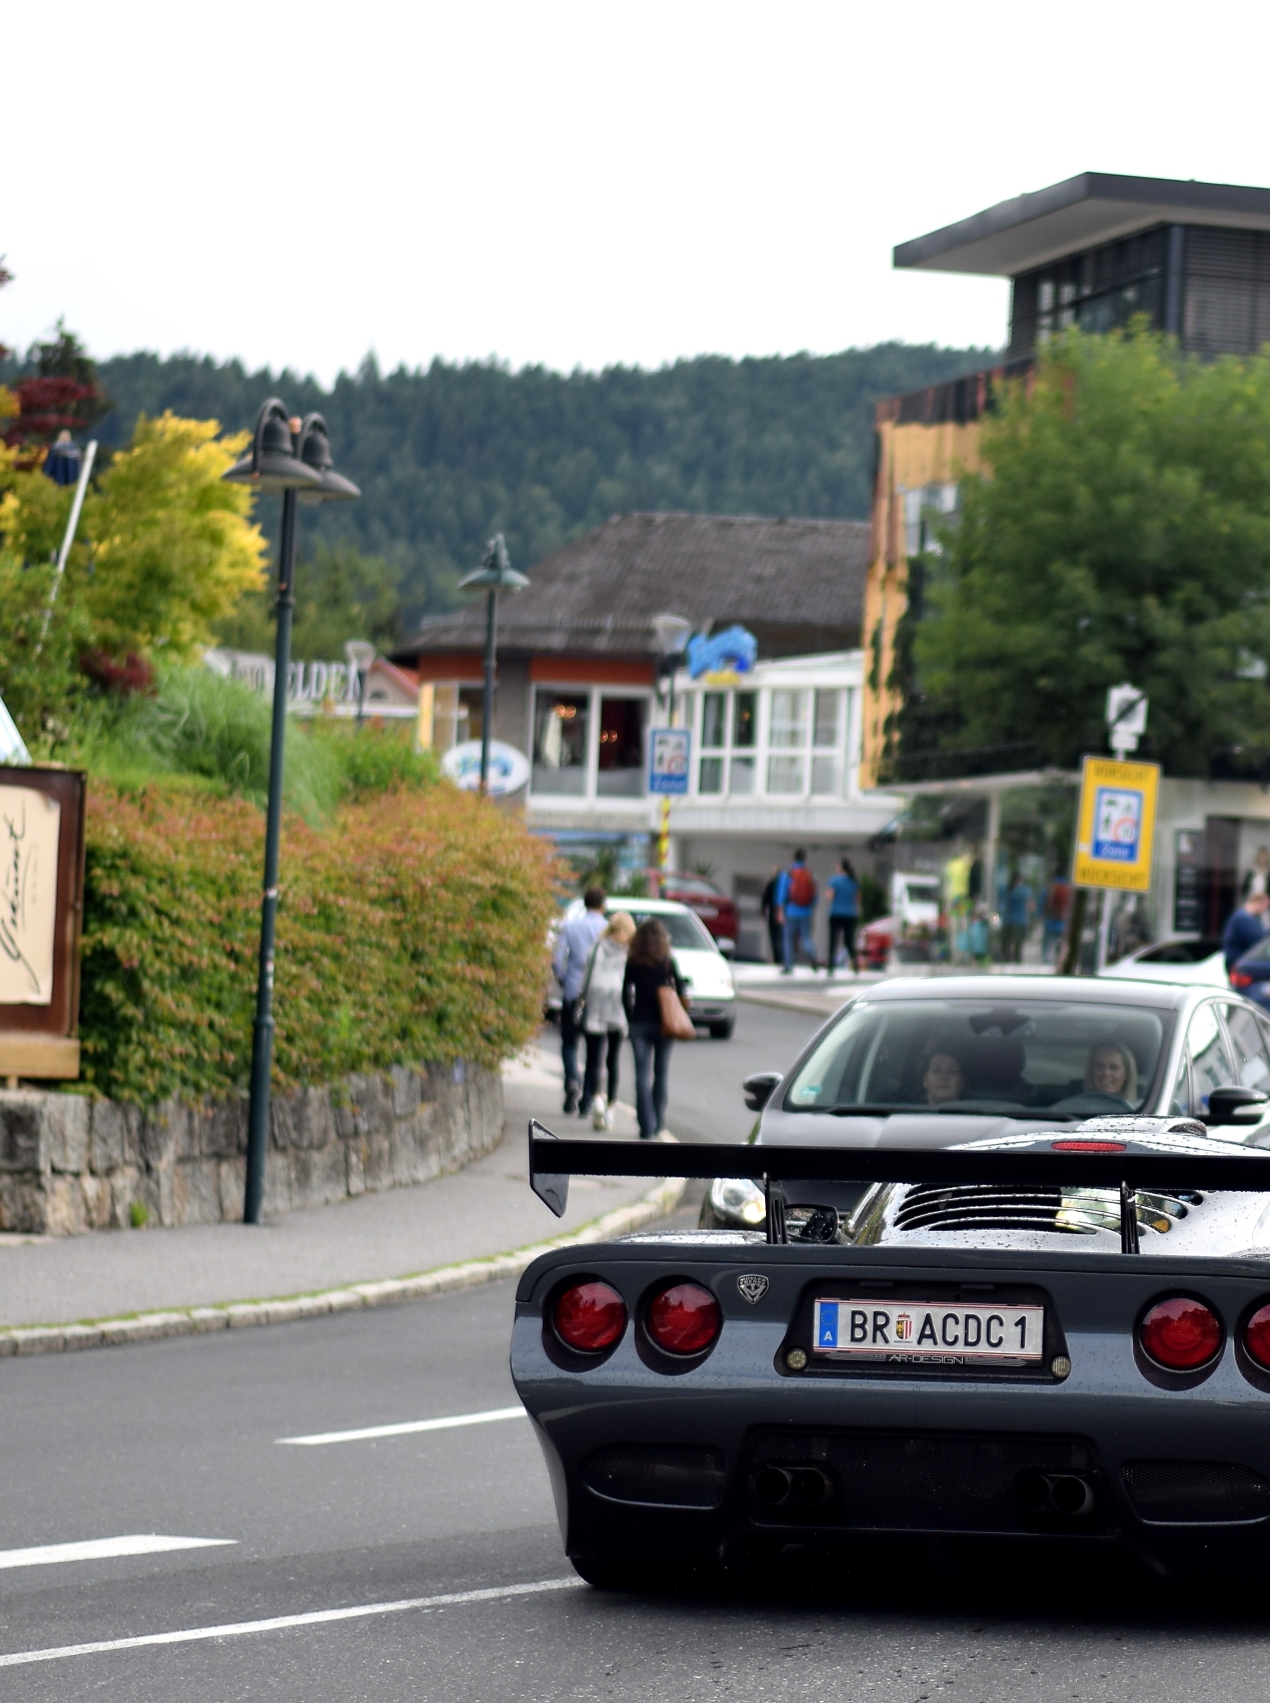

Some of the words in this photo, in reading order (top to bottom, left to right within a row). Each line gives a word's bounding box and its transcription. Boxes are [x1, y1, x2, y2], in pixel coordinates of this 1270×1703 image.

[1095, 764, 1151, 782] VORSICHT
[1101, 845, 1130, 857] Zone
[850, 1309, 891, 1344] BR
[824, 1331, 833, 1342] A
[889, 1354, 965, 1365] AR-DESIGN
